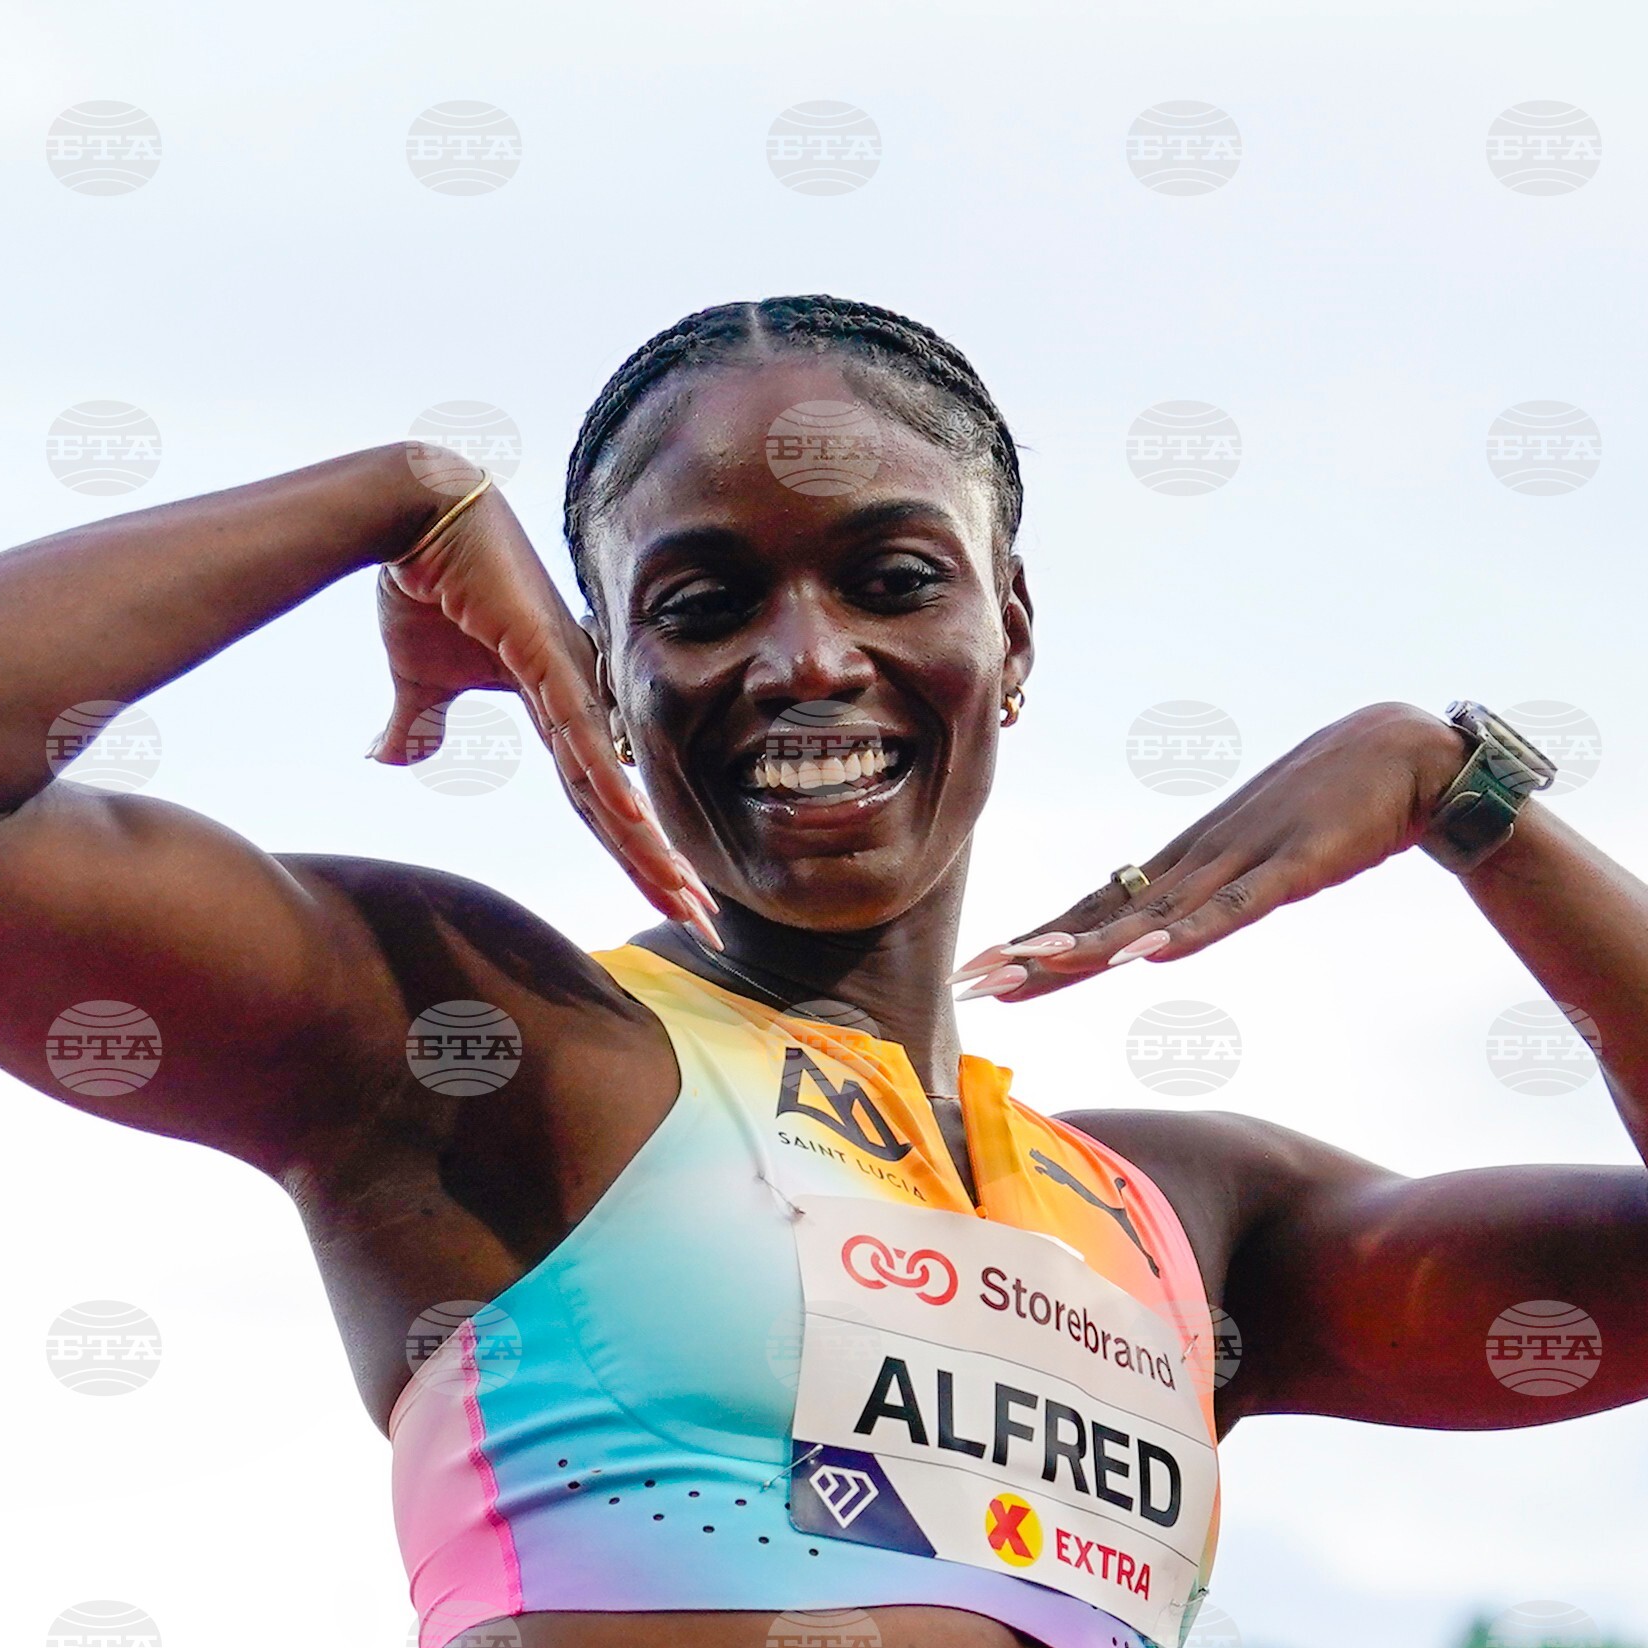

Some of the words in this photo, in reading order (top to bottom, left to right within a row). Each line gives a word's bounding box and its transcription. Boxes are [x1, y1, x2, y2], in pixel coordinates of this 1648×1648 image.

[777, 1130, 847, 1164] SAINT
[855, 1158, 927, 1203] LUCIA
[979, 1265, 1177, 1392] Storebrand
[852, 1355, 1183, 1529] ALFRED
[1055, 1526, 1151, 1602] EXTRA
